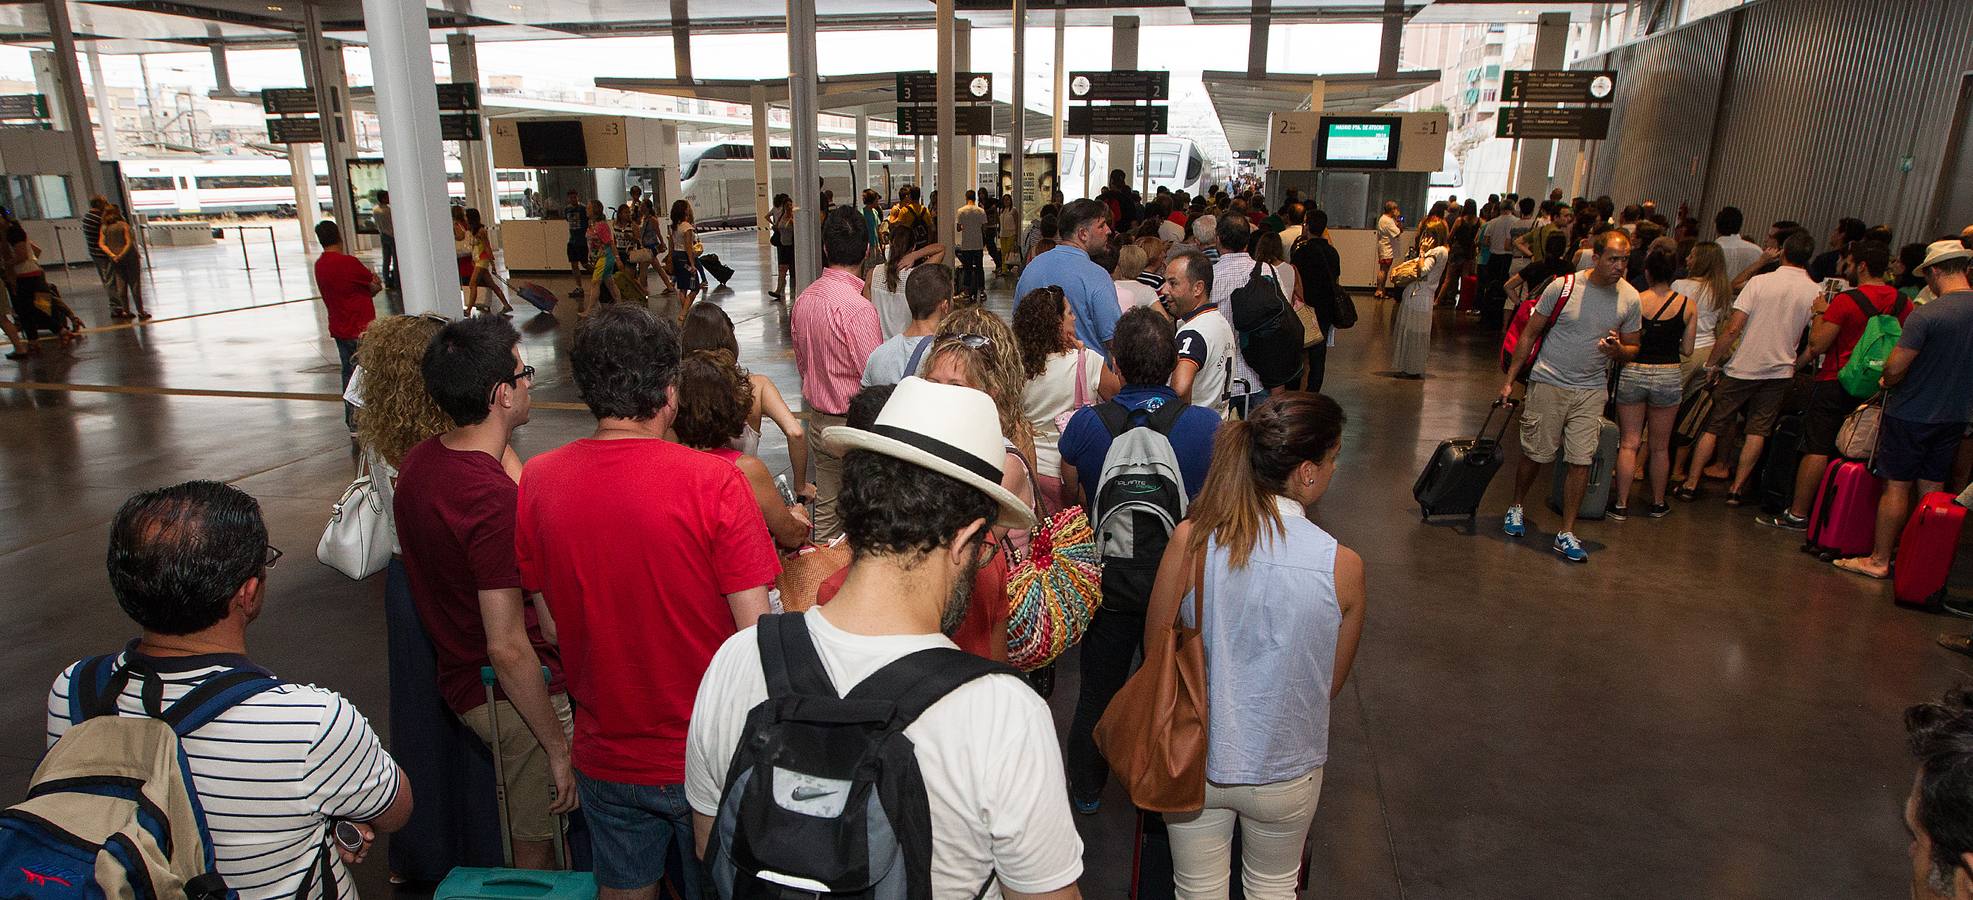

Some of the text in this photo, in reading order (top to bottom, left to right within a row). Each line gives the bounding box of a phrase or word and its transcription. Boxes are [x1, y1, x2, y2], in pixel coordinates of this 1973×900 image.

[904, 87, 911, 99] 3
[1153, 85, 1160, 97] 2
[1511, 86, 1520, 99] 1
[269, 101, 276, 112] 5
[496, 124, 503, 137] 4
[612, 122, 619, 135] 3
[905, 121, 911, 133] 3
[1152, 120, 1159, 131] 2
[1280, 120, 1288, 134] 2
[1429, 120, 1438, 135] 1
[1506, 122, 1514, 135] 1
[274, 131, 280, 140] 5
[1178, 336, 1193, 354] 1
